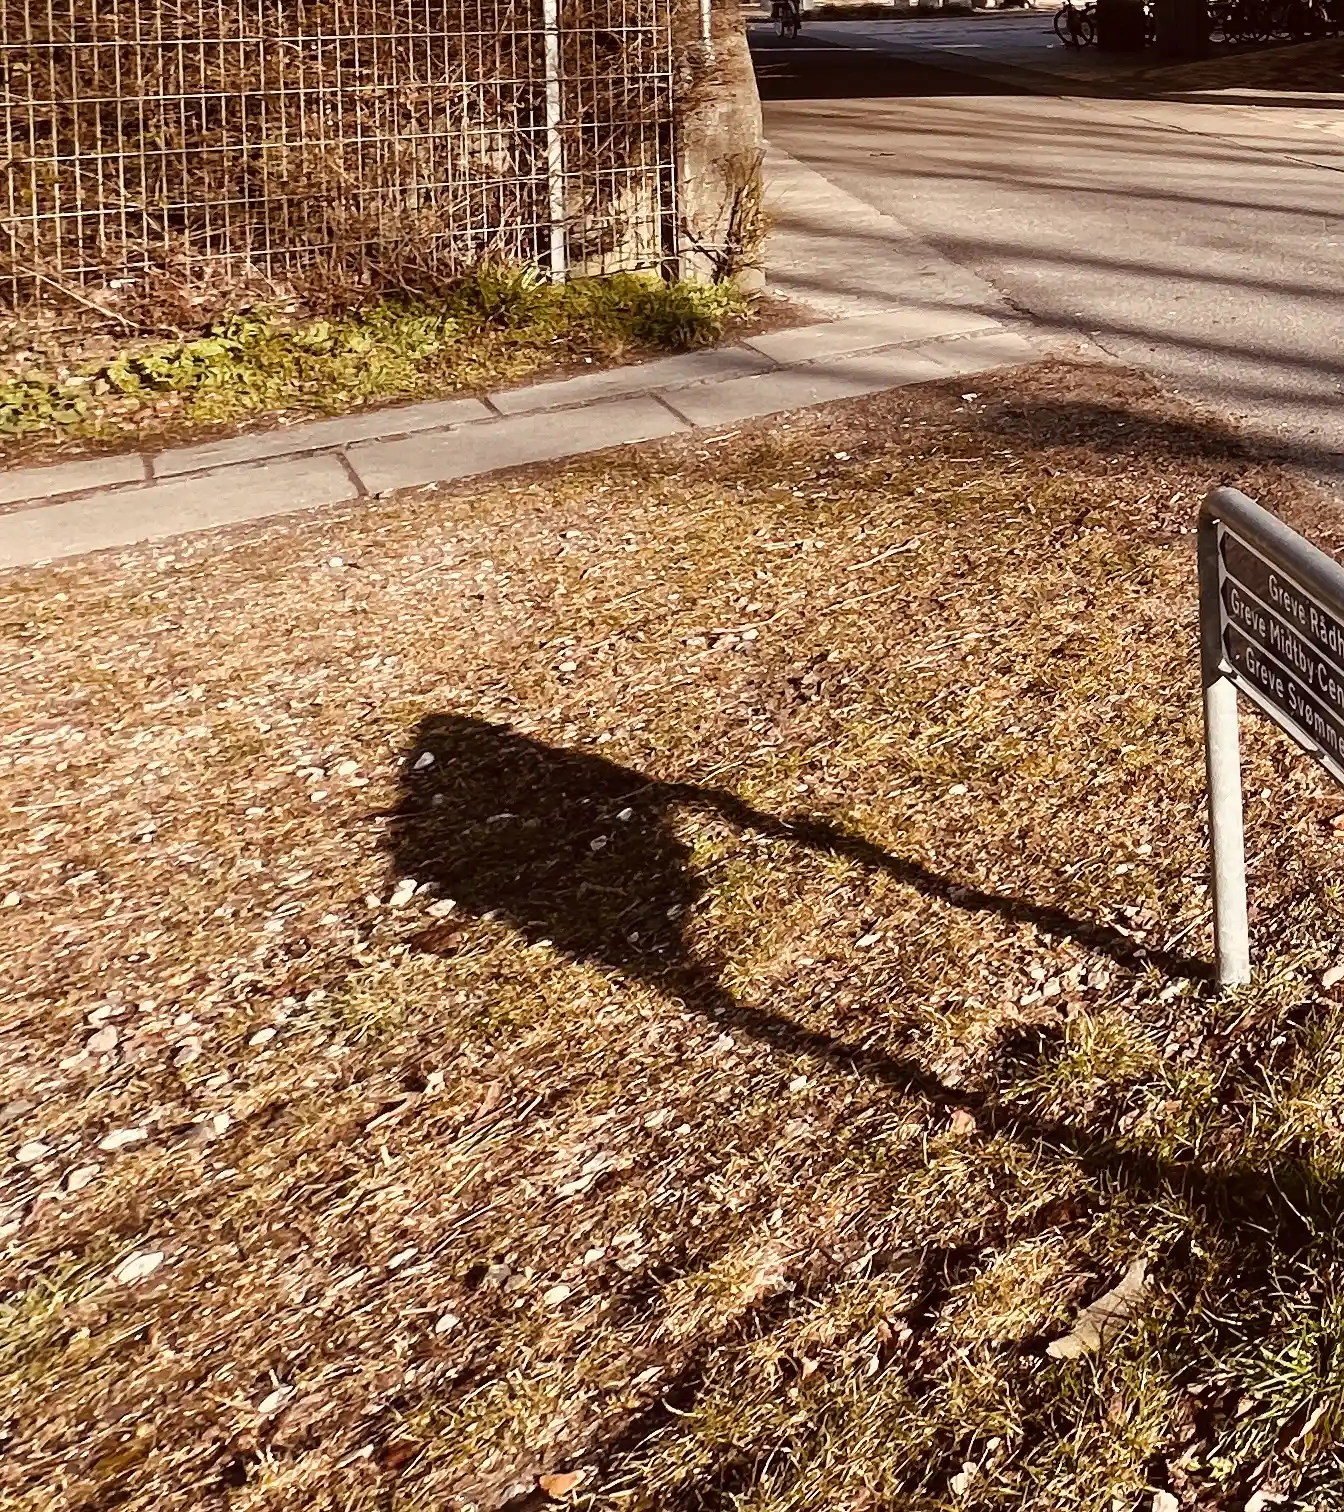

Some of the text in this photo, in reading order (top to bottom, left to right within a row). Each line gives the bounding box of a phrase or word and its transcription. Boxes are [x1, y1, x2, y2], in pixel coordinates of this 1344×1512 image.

[1268, 574, 1306, 625] Greve
[1230, 588, 1266, 638] Greve
[1269, 619, 1314, 684] Midtby
[1245, 647, 1284, 698] Greve
